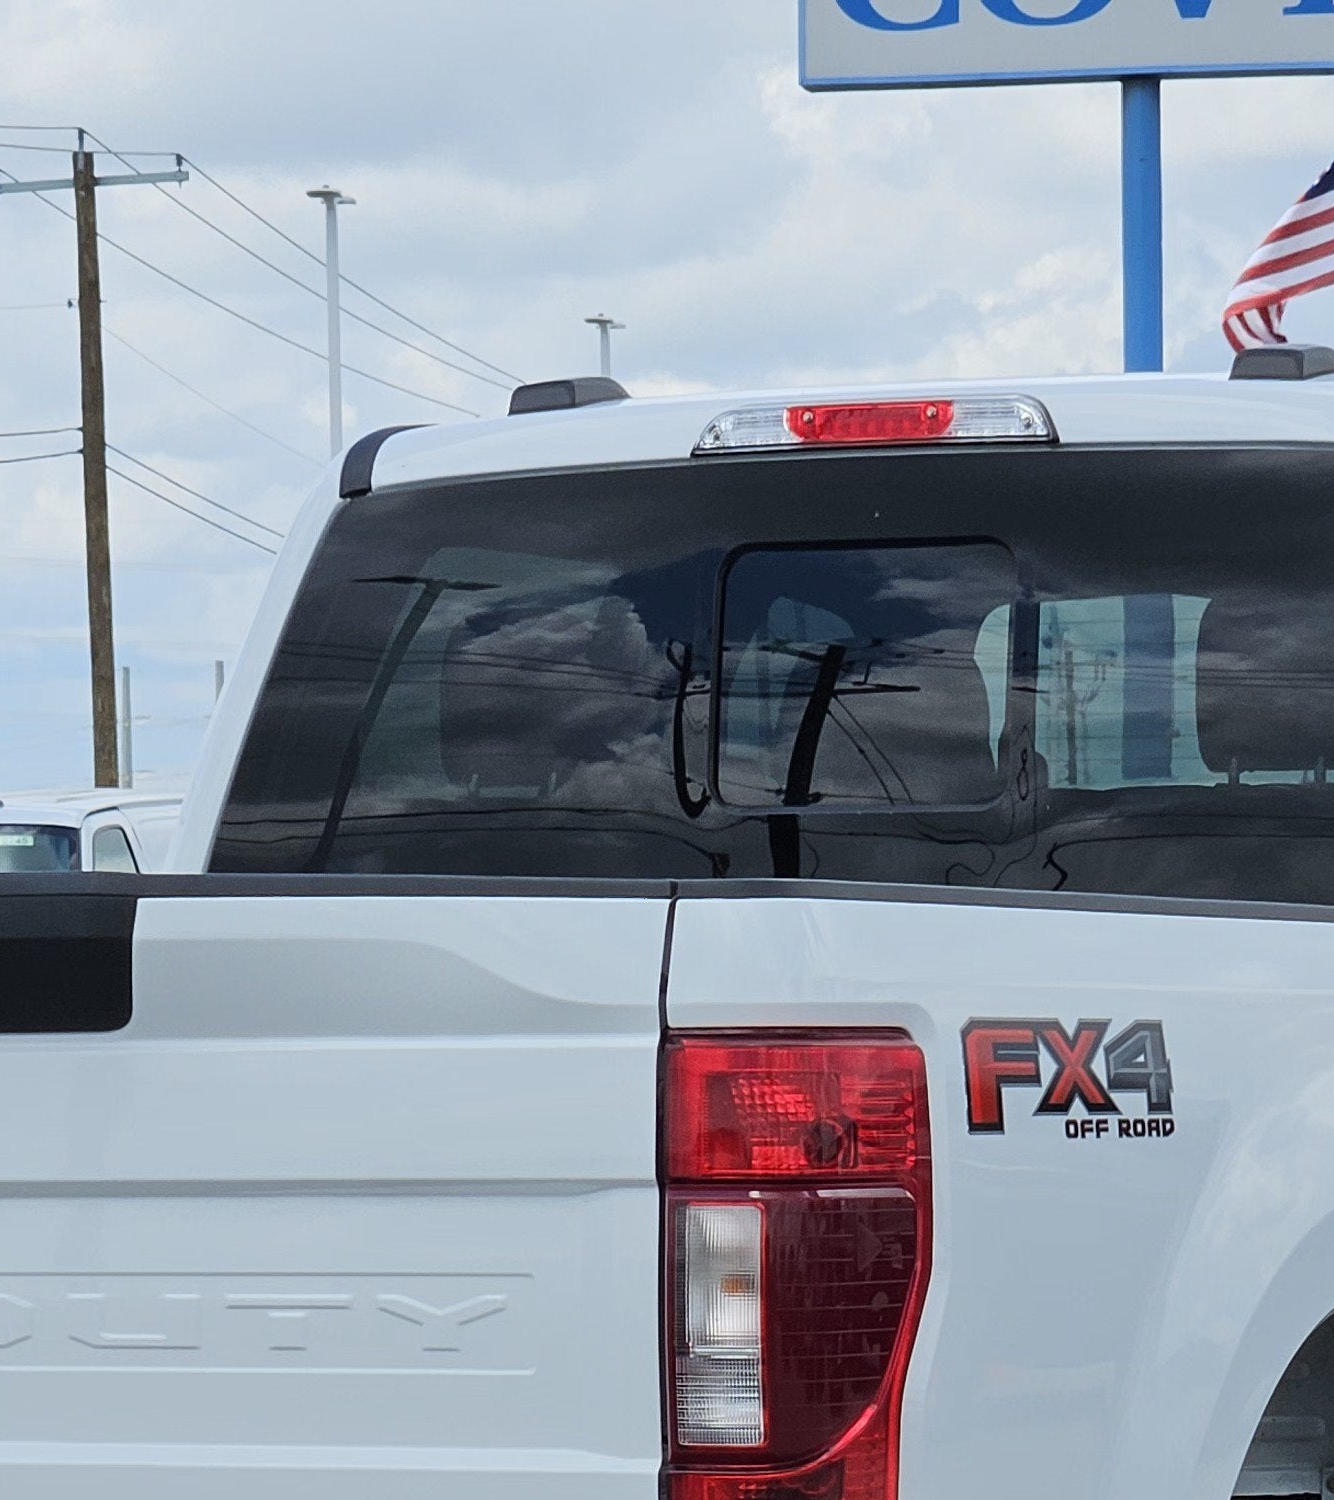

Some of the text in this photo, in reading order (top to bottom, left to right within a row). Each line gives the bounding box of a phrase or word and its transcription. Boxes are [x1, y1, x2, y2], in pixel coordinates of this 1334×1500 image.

[959, 1016, 1174, 1135] FX4
[1065, 1118, 1175, 1139] OFF ROAD
